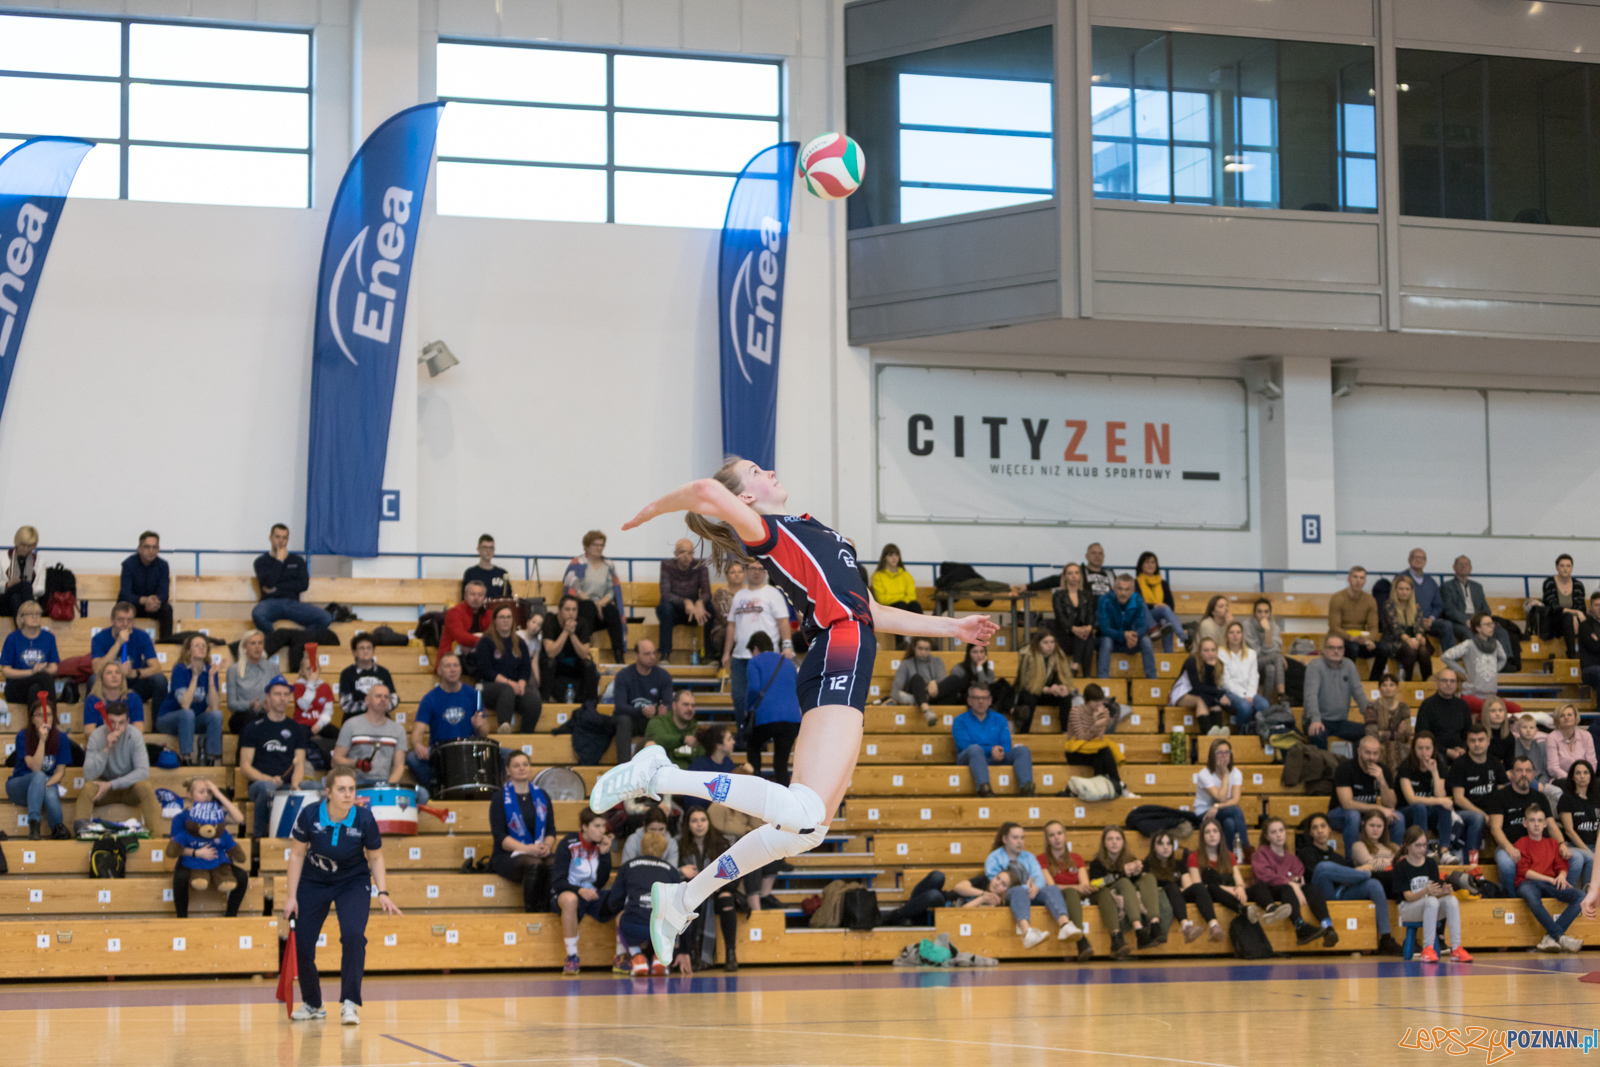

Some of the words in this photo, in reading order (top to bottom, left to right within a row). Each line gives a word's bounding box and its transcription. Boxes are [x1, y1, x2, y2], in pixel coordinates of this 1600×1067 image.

[352, 186, 414, 344] Enea
[747, 216, 782, 365] Enea
[907, 413, 1171, 465] CITYZEN
[990, 464, 1034, 477] WIĘCEJ
[1068, 466, 1098, 478] KLUB
[1105, 468, 1171, 480] SPORTOWY
[382, 494, 396, 516] C
[1306, 519, 1318, 539] B
[830, 676, 848, 690] 12
